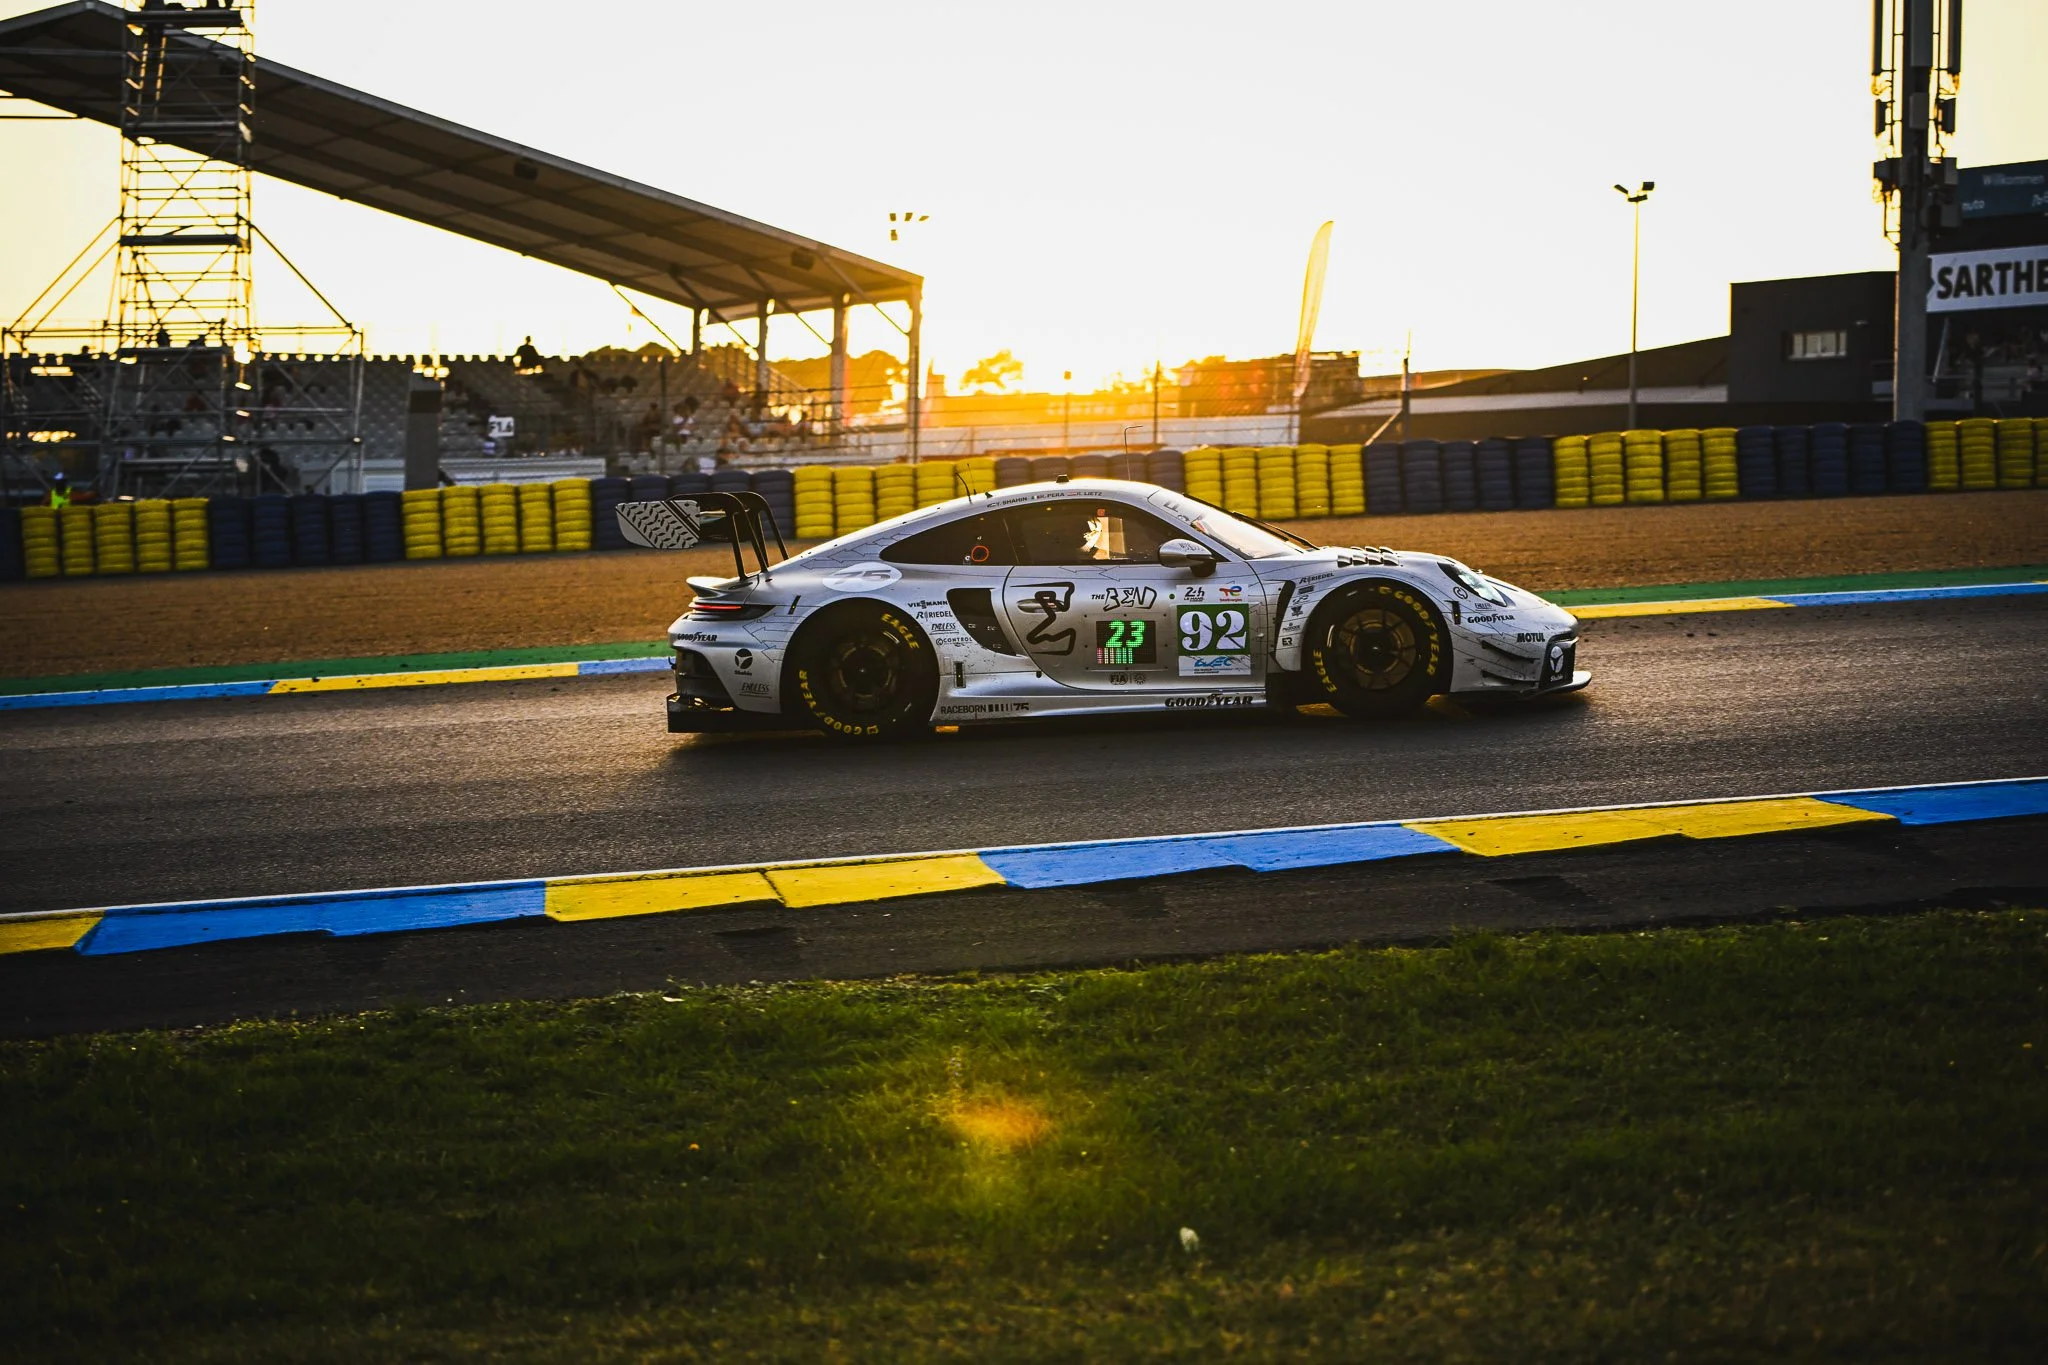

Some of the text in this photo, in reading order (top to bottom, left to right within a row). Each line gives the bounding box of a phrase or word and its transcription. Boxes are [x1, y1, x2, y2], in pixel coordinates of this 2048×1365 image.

[1937, 259, 2048, 299] SARTHE
[1103, 586, 1157, 611] BEND
[881, 612, 919, 649] EAGLE
[1179, 610, 1247, 651] 92
[1467, 614, 1515, 624] GOODYEAR
[1105, 620, 1146, 648] 23
[1516, 632, 1546, 643] MOTUL
[1312, 648, 1338, 693] EAGLE
[940, 704, 987, 715] RACEBORN
[1164, 693, 1253, 708] GOODYEAR
